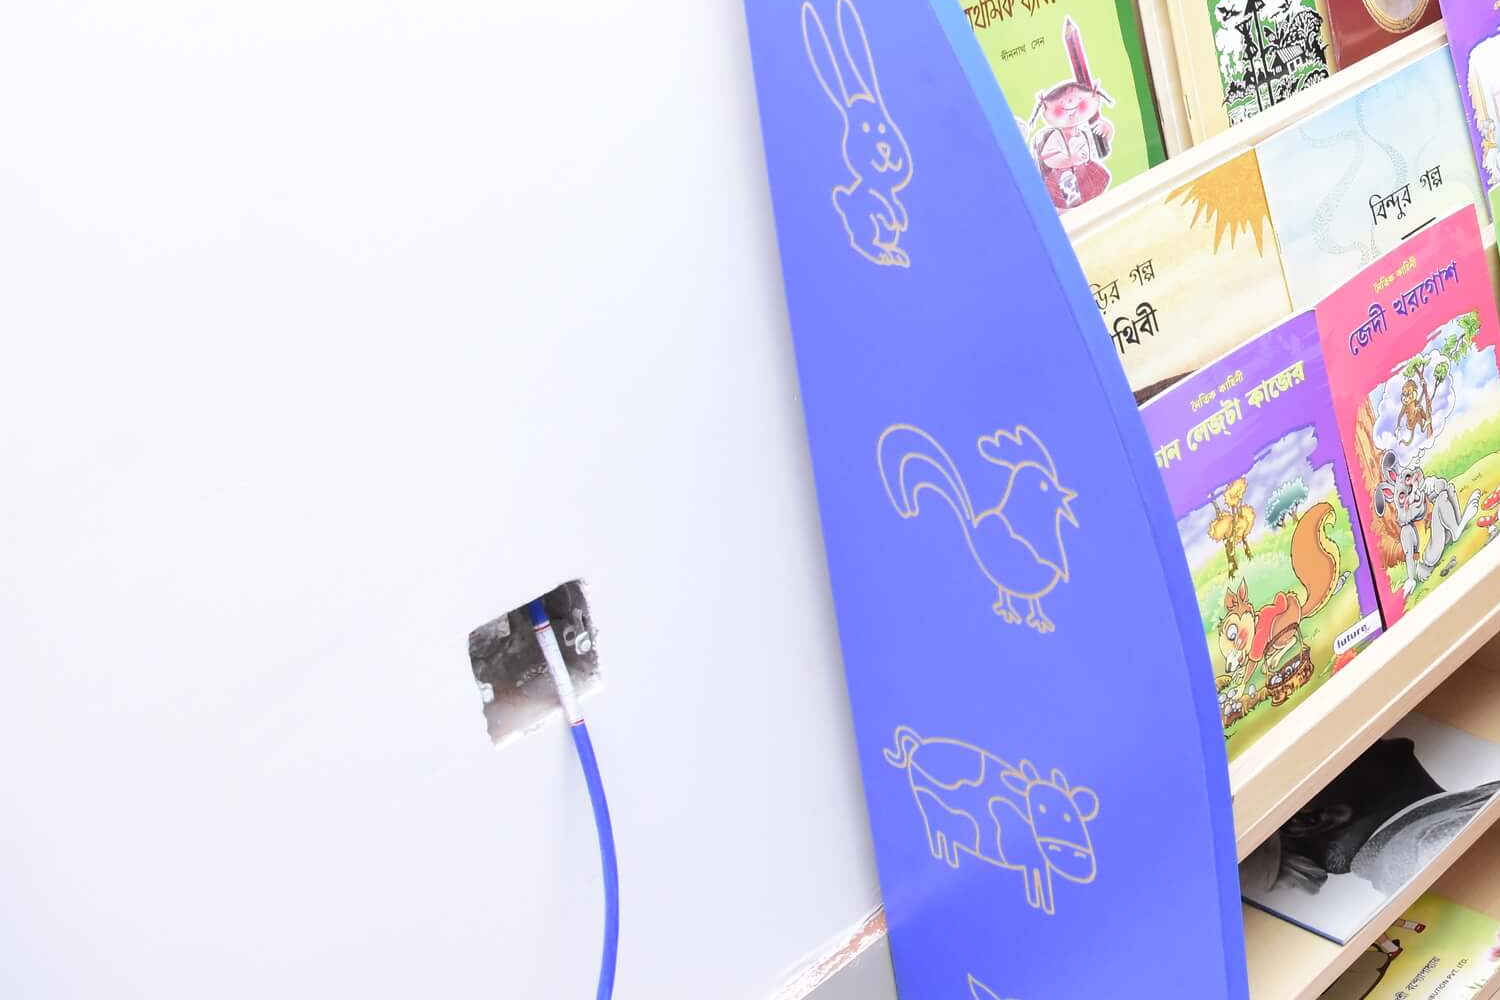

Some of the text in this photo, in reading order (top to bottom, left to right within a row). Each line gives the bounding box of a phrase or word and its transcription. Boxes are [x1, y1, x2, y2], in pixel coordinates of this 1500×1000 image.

[1369, 165, 1443, 225] বিন্দুর গল্প
[1129, 258, 1156, 286] গল্প
[1110, 302, 1159, 354] থিবী
[1349, 260, 1459, 356] জেদী খরগোশ
[1245, 360, 1305, 408] কাজের
[1337, 624, 1369, 649] future
